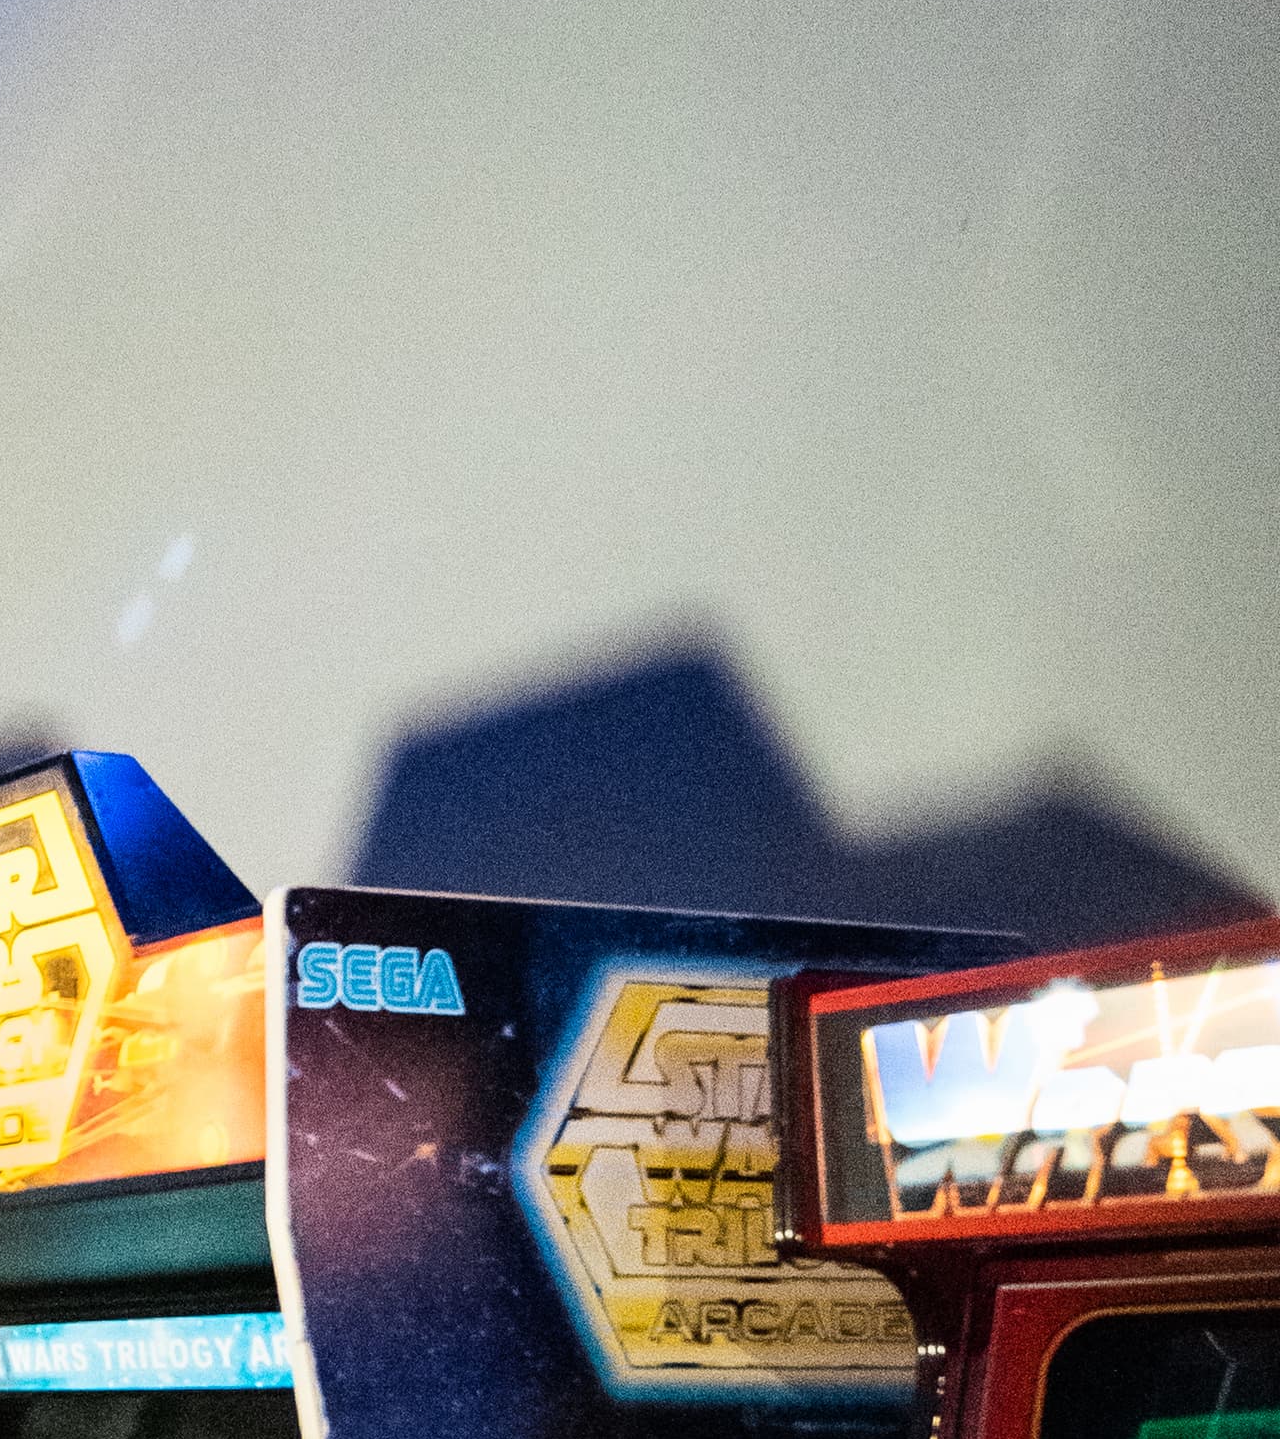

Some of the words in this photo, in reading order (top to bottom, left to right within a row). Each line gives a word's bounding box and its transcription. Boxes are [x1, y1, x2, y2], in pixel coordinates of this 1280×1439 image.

[297, 941, 466, 1016] SEGA
[648, 1298, 916, 1345] ARCADE
[8, 1341, 86, 1374] WARS
[93, 1336, 234, 1372] TRILOGY
